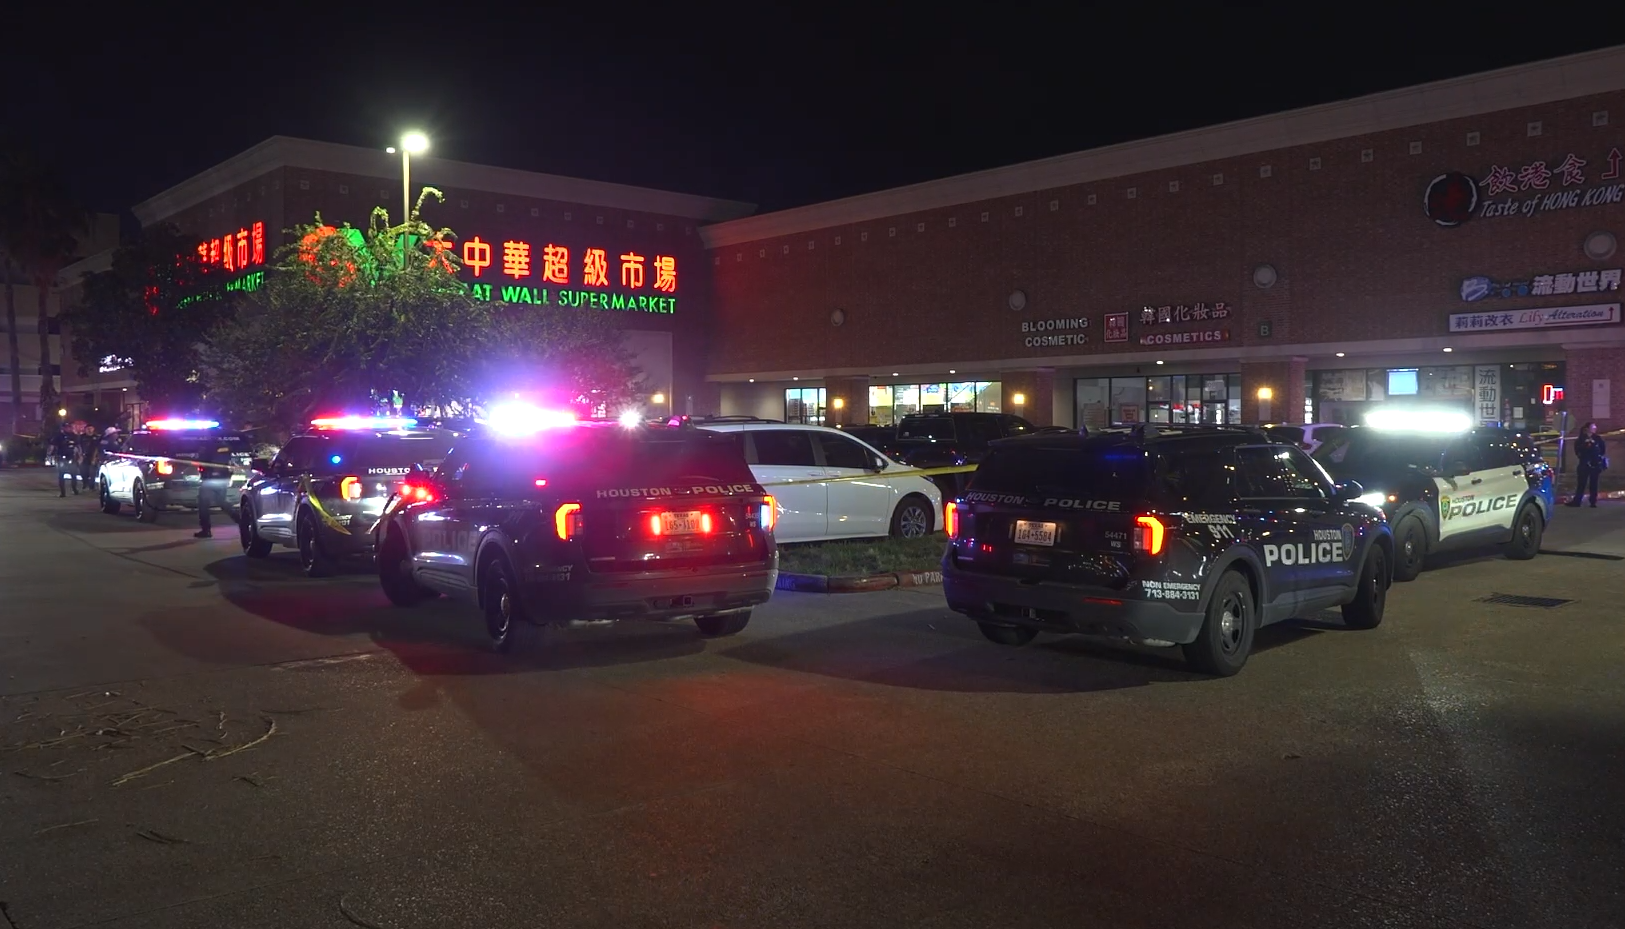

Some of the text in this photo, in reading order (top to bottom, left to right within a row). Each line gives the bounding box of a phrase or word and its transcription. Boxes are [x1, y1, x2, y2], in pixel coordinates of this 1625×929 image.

[1480, 184, 1625, 217] Taste of HONG KONG
[1531, 269, 1621, 295] 流動世界
[502, 286, 549, 305] WALL
[558, 290, 676, 314] SUPERMARKET
[1546, 308, 1604, 320] Alteration
[1021, 317, 1089, 333] BLOOMING
[1260, 325, 1269, 336] B
[1025, 334, 1086, 347] COSMETIC
[1146, 330, 1221, 345] COSMETICS
[597, 484, 754, 498] HOUSTON POLICE
[966, 491, 1121, 511] HOUSTON POLICE
[1448, 494, 1518, 520] POLICE
[1185, 514, 1237, 524] EMERGENCY
[1208, 524, 1234, 539] 911
[1313, 529, 1342, 540] HOUSTON
[1263, 542, 1344, 567] POLICE
[1142, 580, 1200, 591] NON EMERGENCY
[1146, 588, 1200, 600] 713-884-3131
